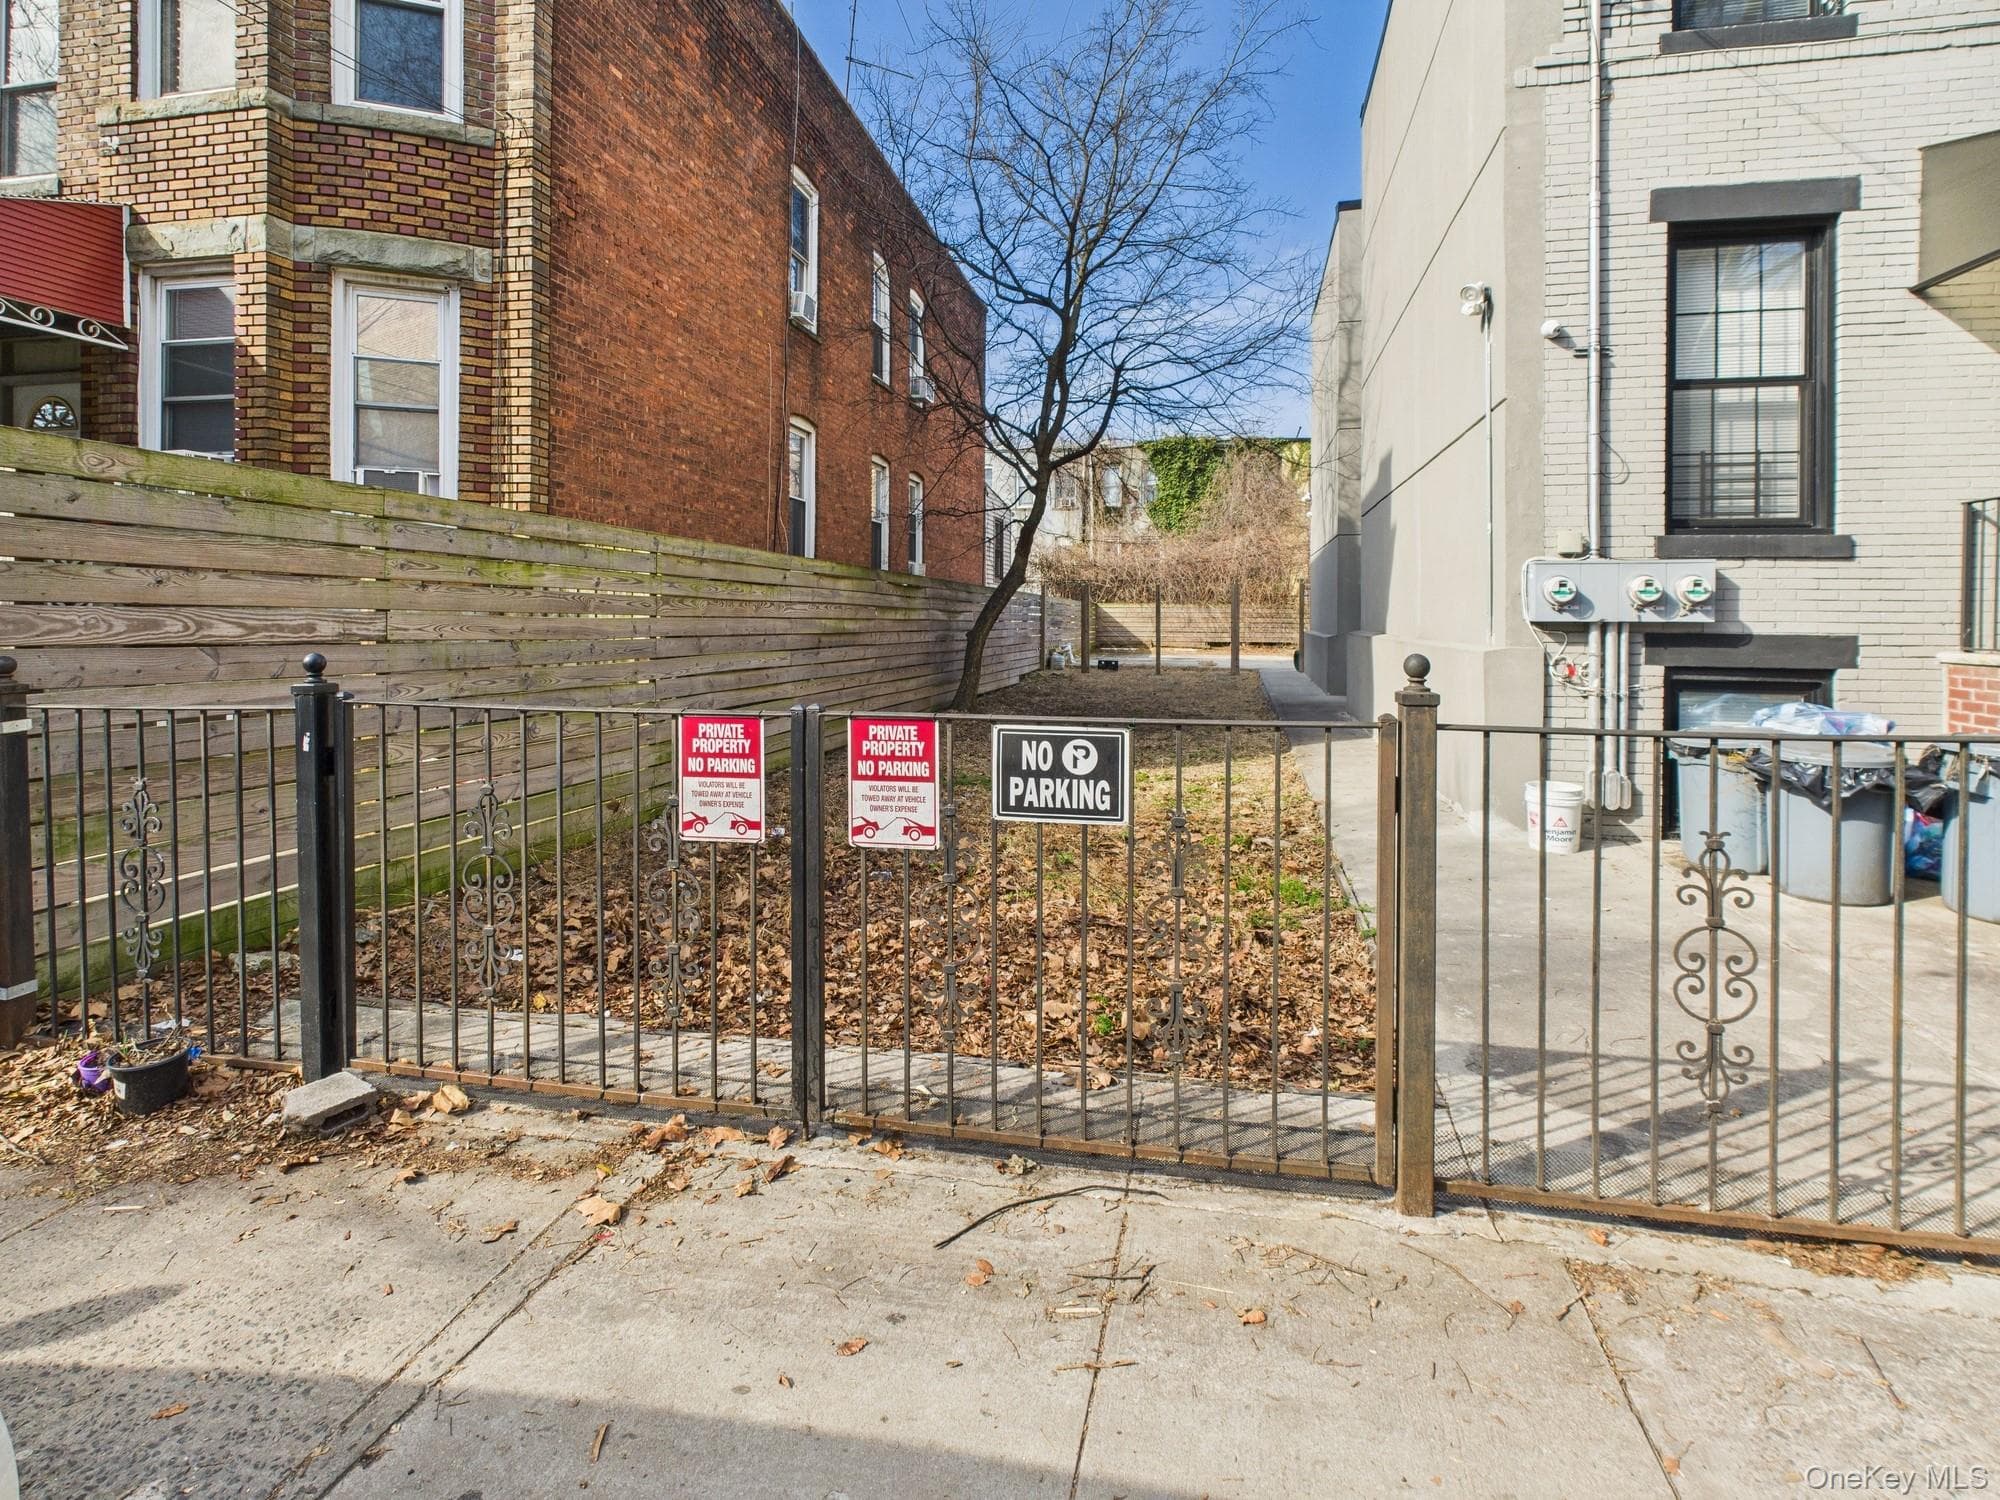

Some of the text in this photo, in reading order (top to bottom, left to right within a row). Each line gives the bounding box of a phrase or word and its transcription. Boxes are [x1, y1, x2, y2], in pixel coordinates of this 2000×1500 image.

[698, 723, 744, 738] PRIVATE
[869, 725, 918, 740] PRIVATE
[692, 738, 751, 754] PROPERTY
[862, 740, 925, 756] PROPERTY
[1022, 740, 1053, 772] NO
[688, 757, 756, 773] NO PARKING
[858, 760, 930, 777] NO PARKING
[881, 794, 896, 802] AWAY
[1009, 776, 1110, 811] PARKING
